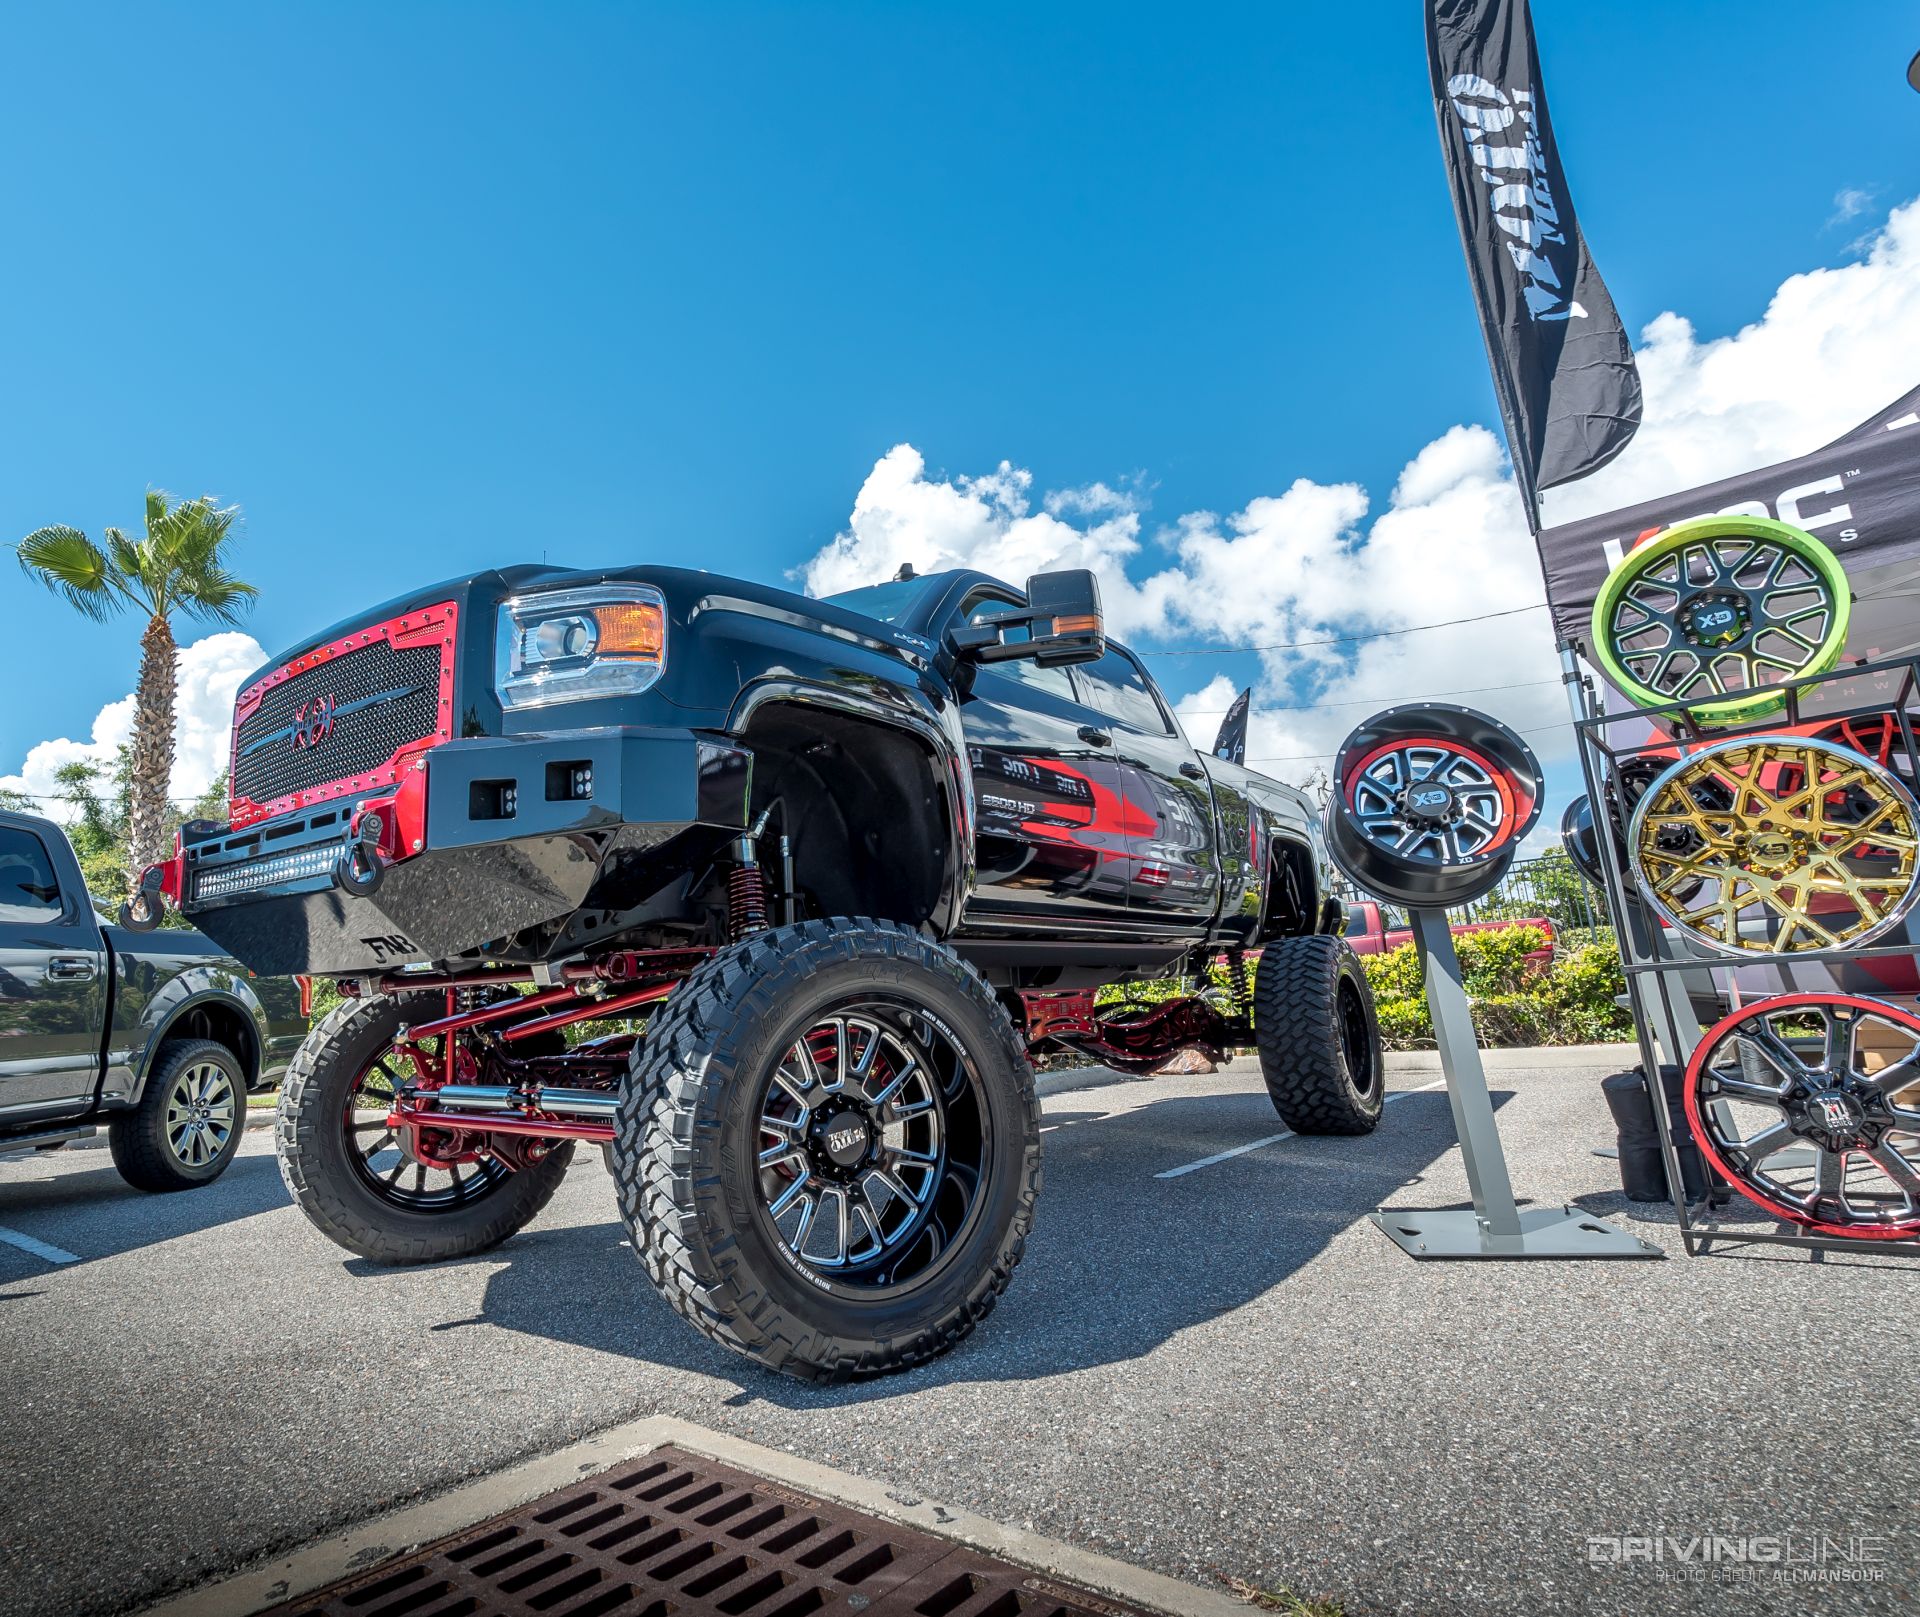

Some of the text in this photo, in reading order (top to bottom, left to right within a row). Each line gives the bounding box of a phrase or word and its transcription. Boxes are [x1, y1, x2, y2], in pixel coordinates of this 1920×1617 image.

[1697, 610, 1732, 629] XD
[1018, 801, 1035, 815] HD
[1411, 790, 1447, 808] XD
[1458, 856, 1473, 864] XD
[936, 1019, 952, 1037] METAL
[830, 1127, 866, 1152] MOTO
[796, 1263, 815, 1281] METAL
